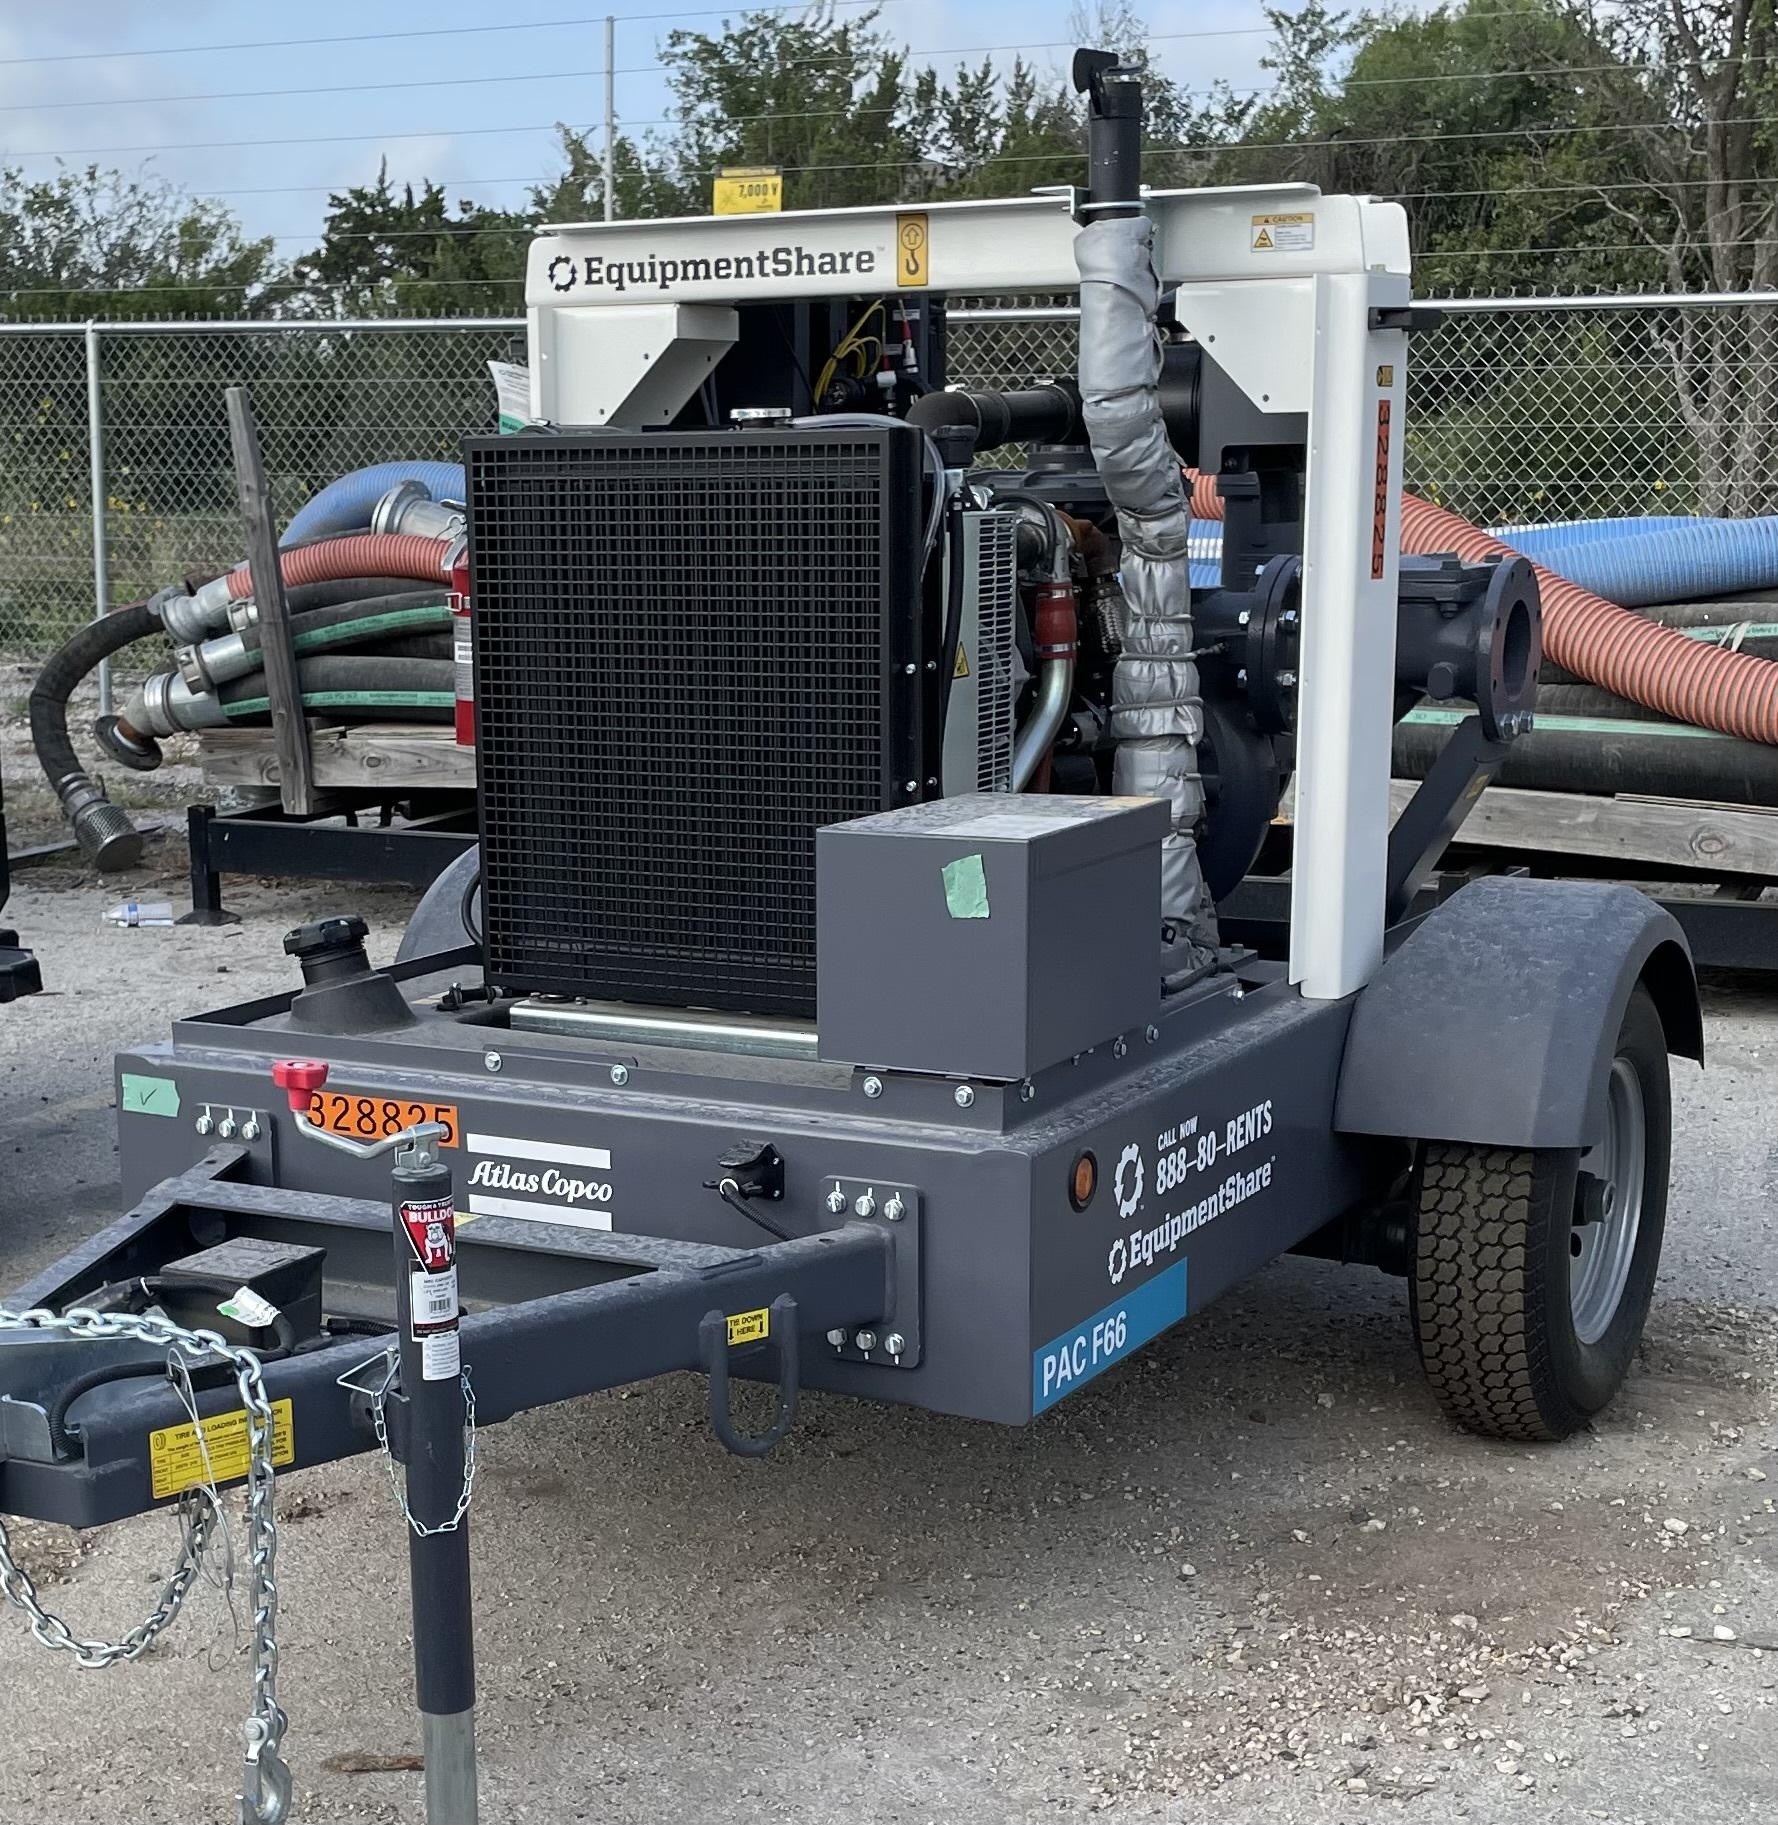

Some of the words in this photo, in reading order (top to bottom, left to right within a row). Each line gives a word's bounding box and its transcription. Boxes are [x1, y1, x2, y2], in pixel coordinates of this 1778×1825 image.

[739, 184, 769, 198] 7,000
[771, 183, 780, 196] V
[584, 247, 875, 291] EquipmentShare
[1371, 405, 1391, 575] 328825
[1158, 1127, 1177, 1152] CALL
[1179, 1115, 1199, 1141] NOW
[467, 1160, 540, 1193] Atlas
[541, 1168, 613, 1203] Copco
[408, 1206, 453, 1223] BULLDO
[1129, 1161, 1272, 1269] EquipmentShare
[736, 1325, 756, 1335] HERE
[741, 1313, 763, 1324] DOWN
[1043, 1335, 1087, 1398] PAC
[1092, 1310, 1127, 1365] F66
[175, 1431, 190, 1440] TIRE
[207, 1419, 238, 1431] LOADING
